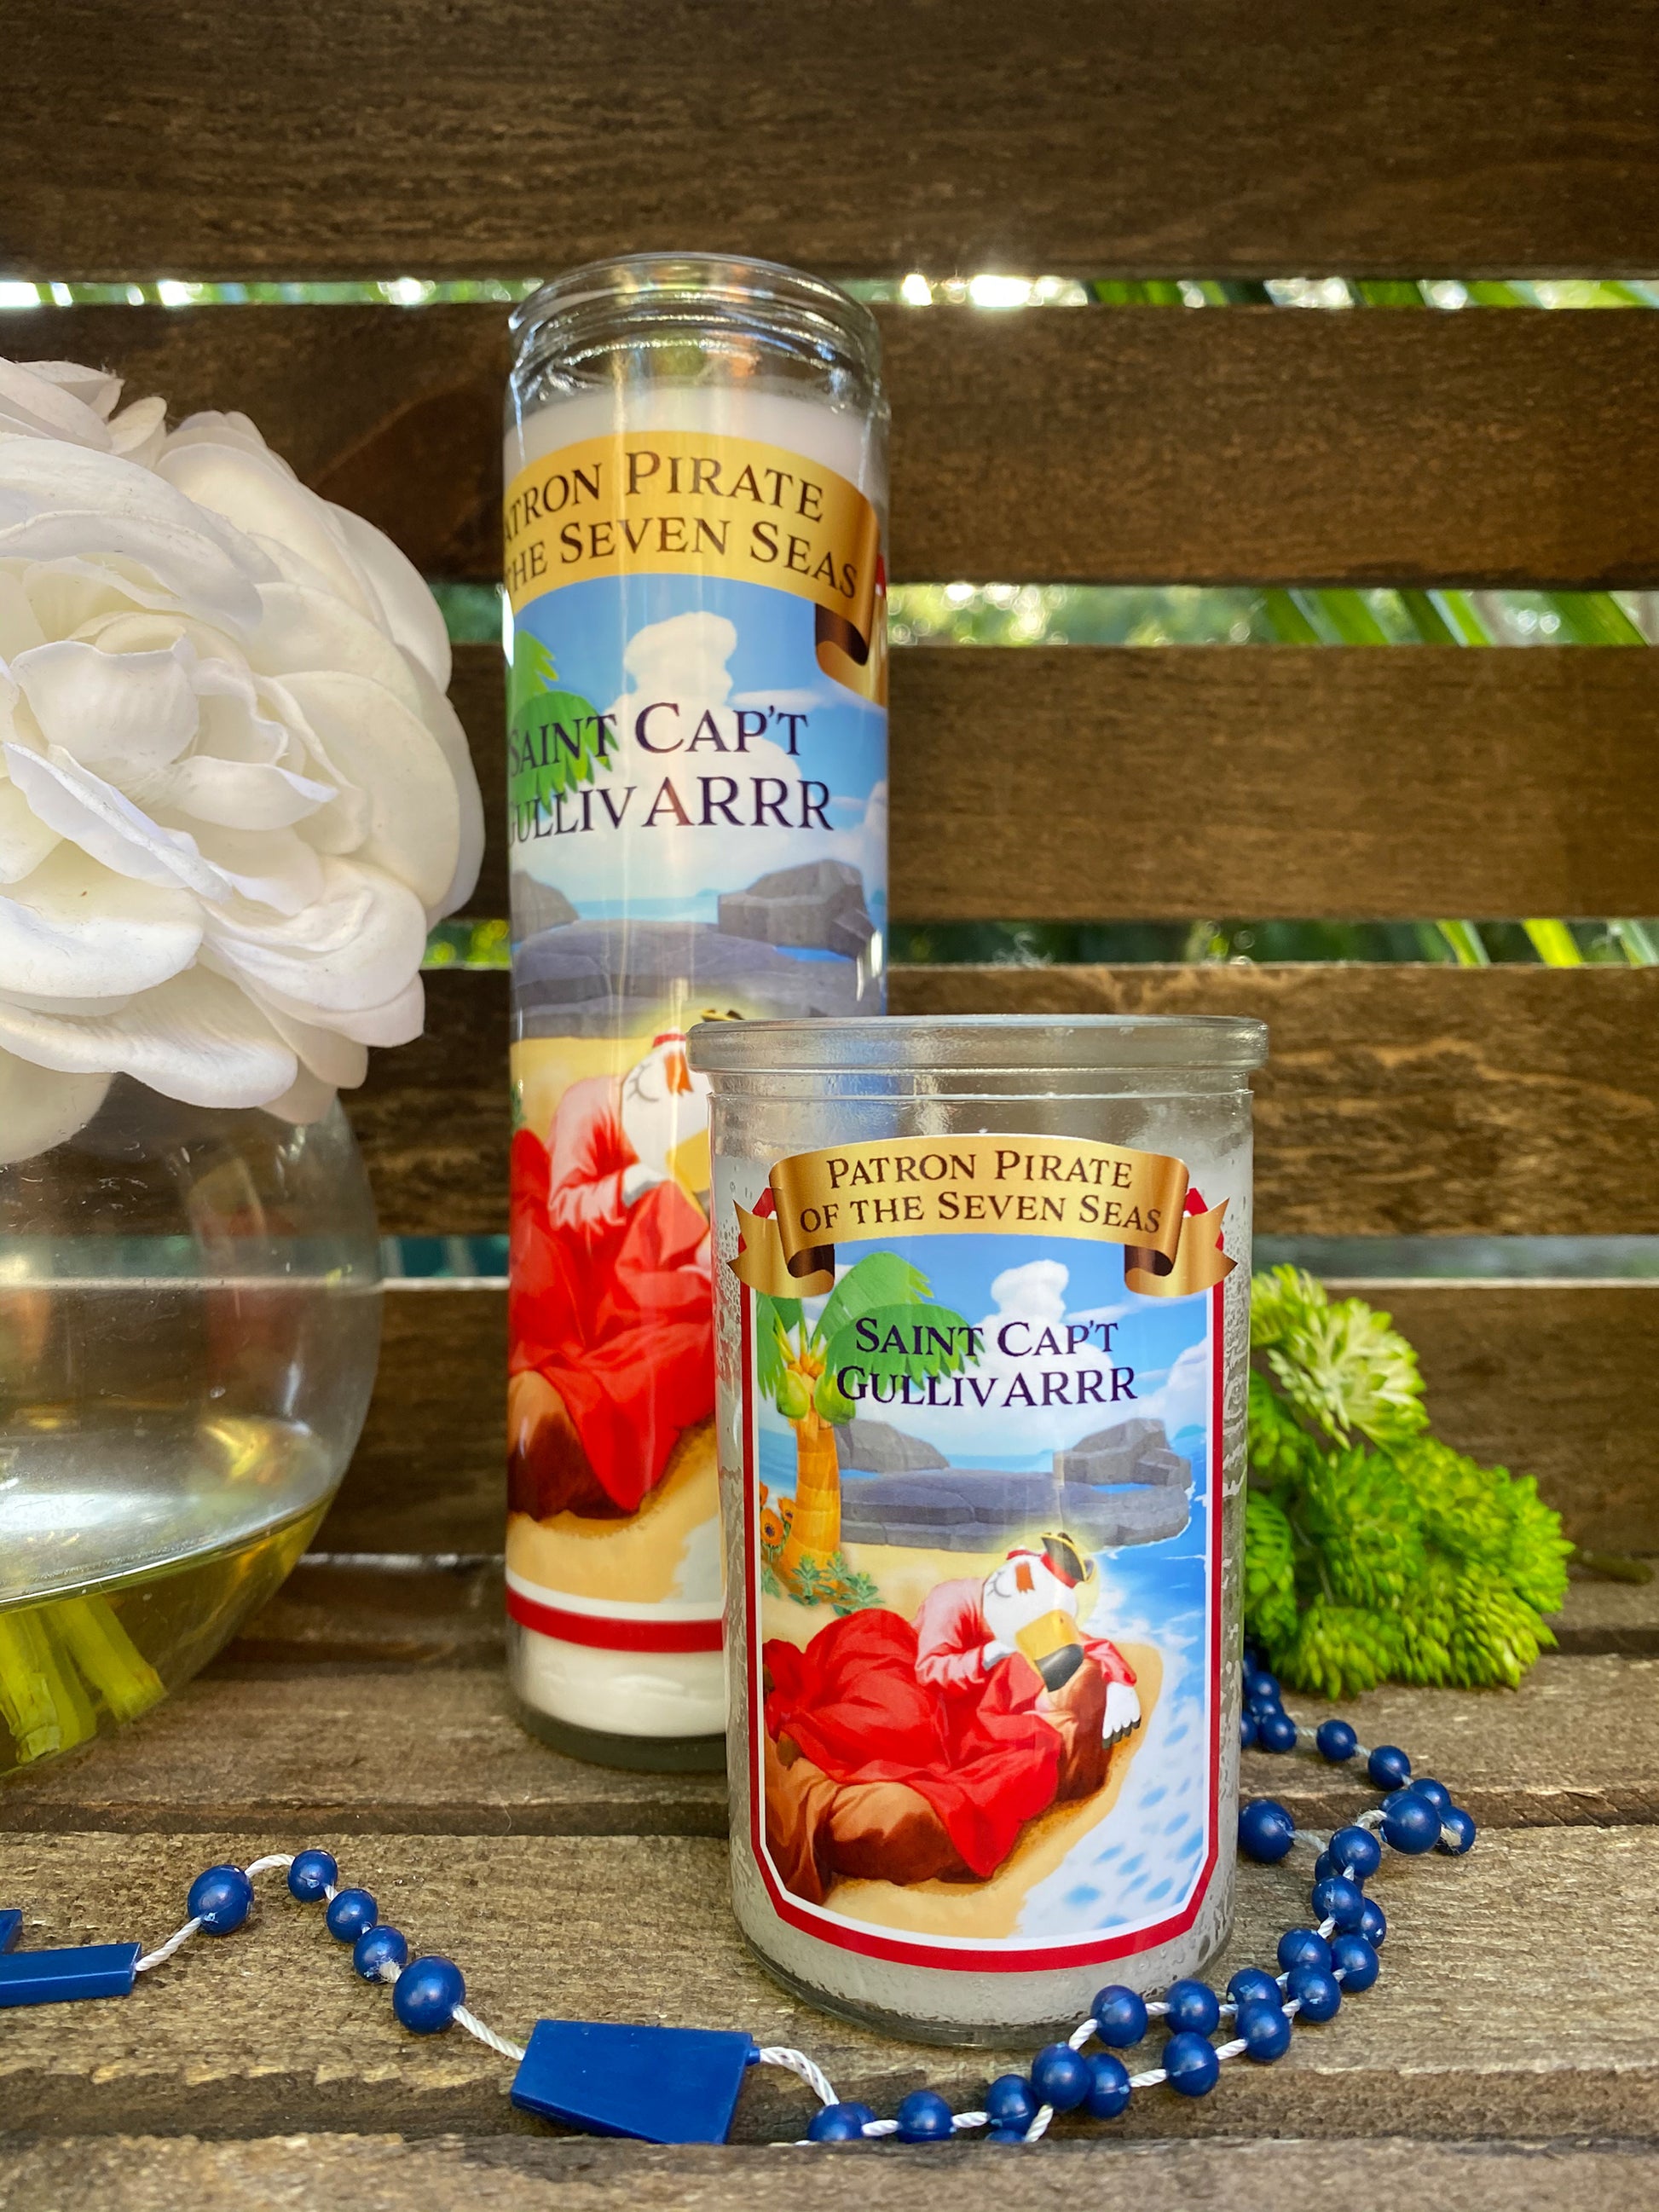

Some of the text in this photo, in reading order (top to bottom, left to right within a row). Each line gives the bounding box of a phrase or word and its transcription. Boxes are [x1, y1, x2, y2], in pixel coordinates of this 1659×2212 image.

[626, 450, 824, 523] PIRATE
[560, 517, 731, 566] SEVEN
[749, 521, 858, 600] SEAS
[510, 702, 808, 778] SAINT CAP'T
[826, 1150, 1133, 1189] PATRON PIRATE
[800, 1192, 1162, 1233] OF THE SEVEN SEAS
[855, 1318, 1119, 1357] SAINT CAP'T
[835, 1366, 1139, 1407] GULLIVARRR
